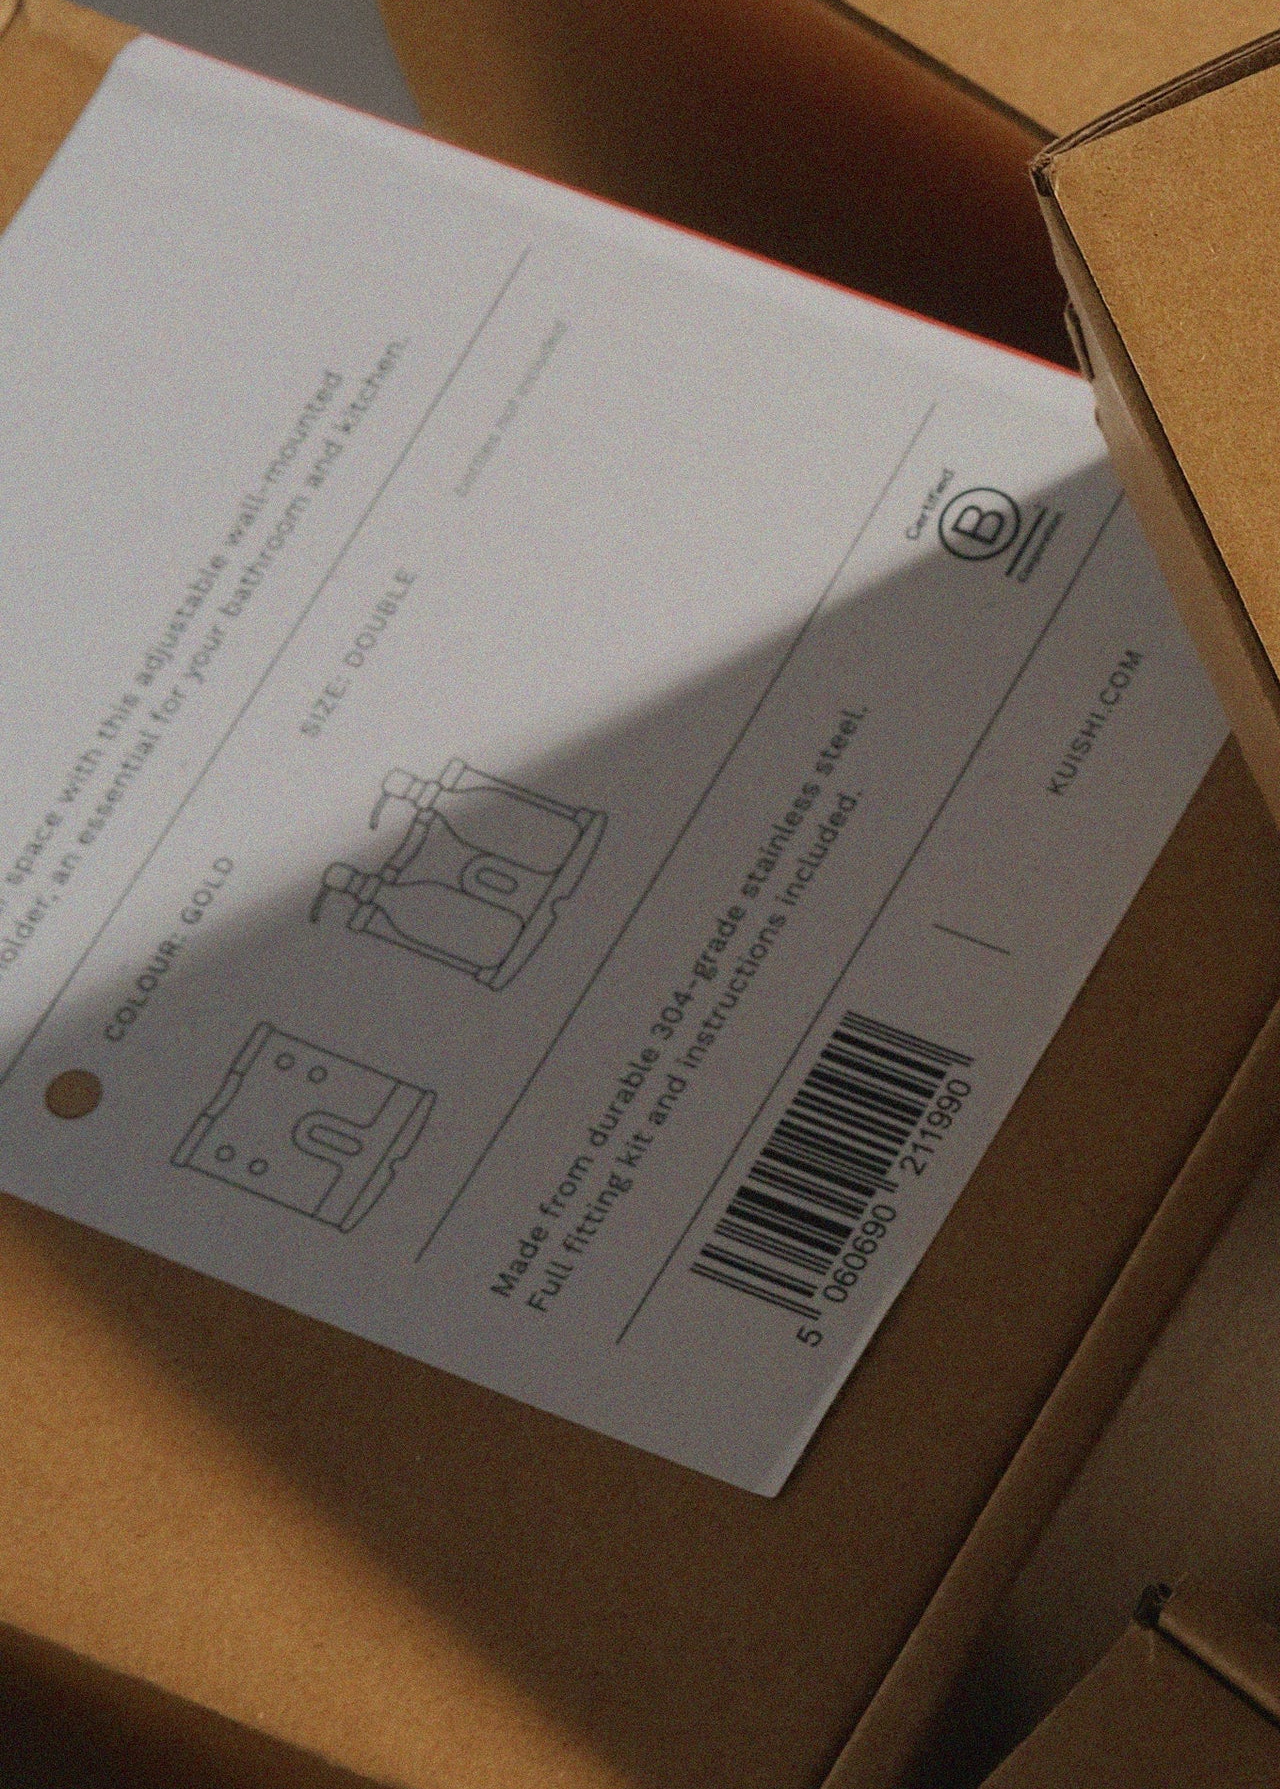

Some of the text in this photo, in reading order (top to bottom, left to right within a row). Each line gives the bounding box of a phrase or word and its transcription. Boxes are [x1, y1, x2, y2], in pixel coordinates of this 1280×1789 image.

[0, 337, 410, 970] older, an essential for your bathroom and kitchen.
[4, 368, 344, 886] space with this adjustable wall-mounted
[298, 567, 419, 740] SIZE: DOUBLE
[1045, 648, 1145, 797] KUISHI.COM
[102, 855, 235, 1044] COLOUR: GOLD
[488, 706, 869, 1299] Made from durable 304-grade stainless steel.
[524, 790, 864, 1314] Full fitting kit and instructions included.
[794, 1079, 973, 1349] 5 060690 211990
